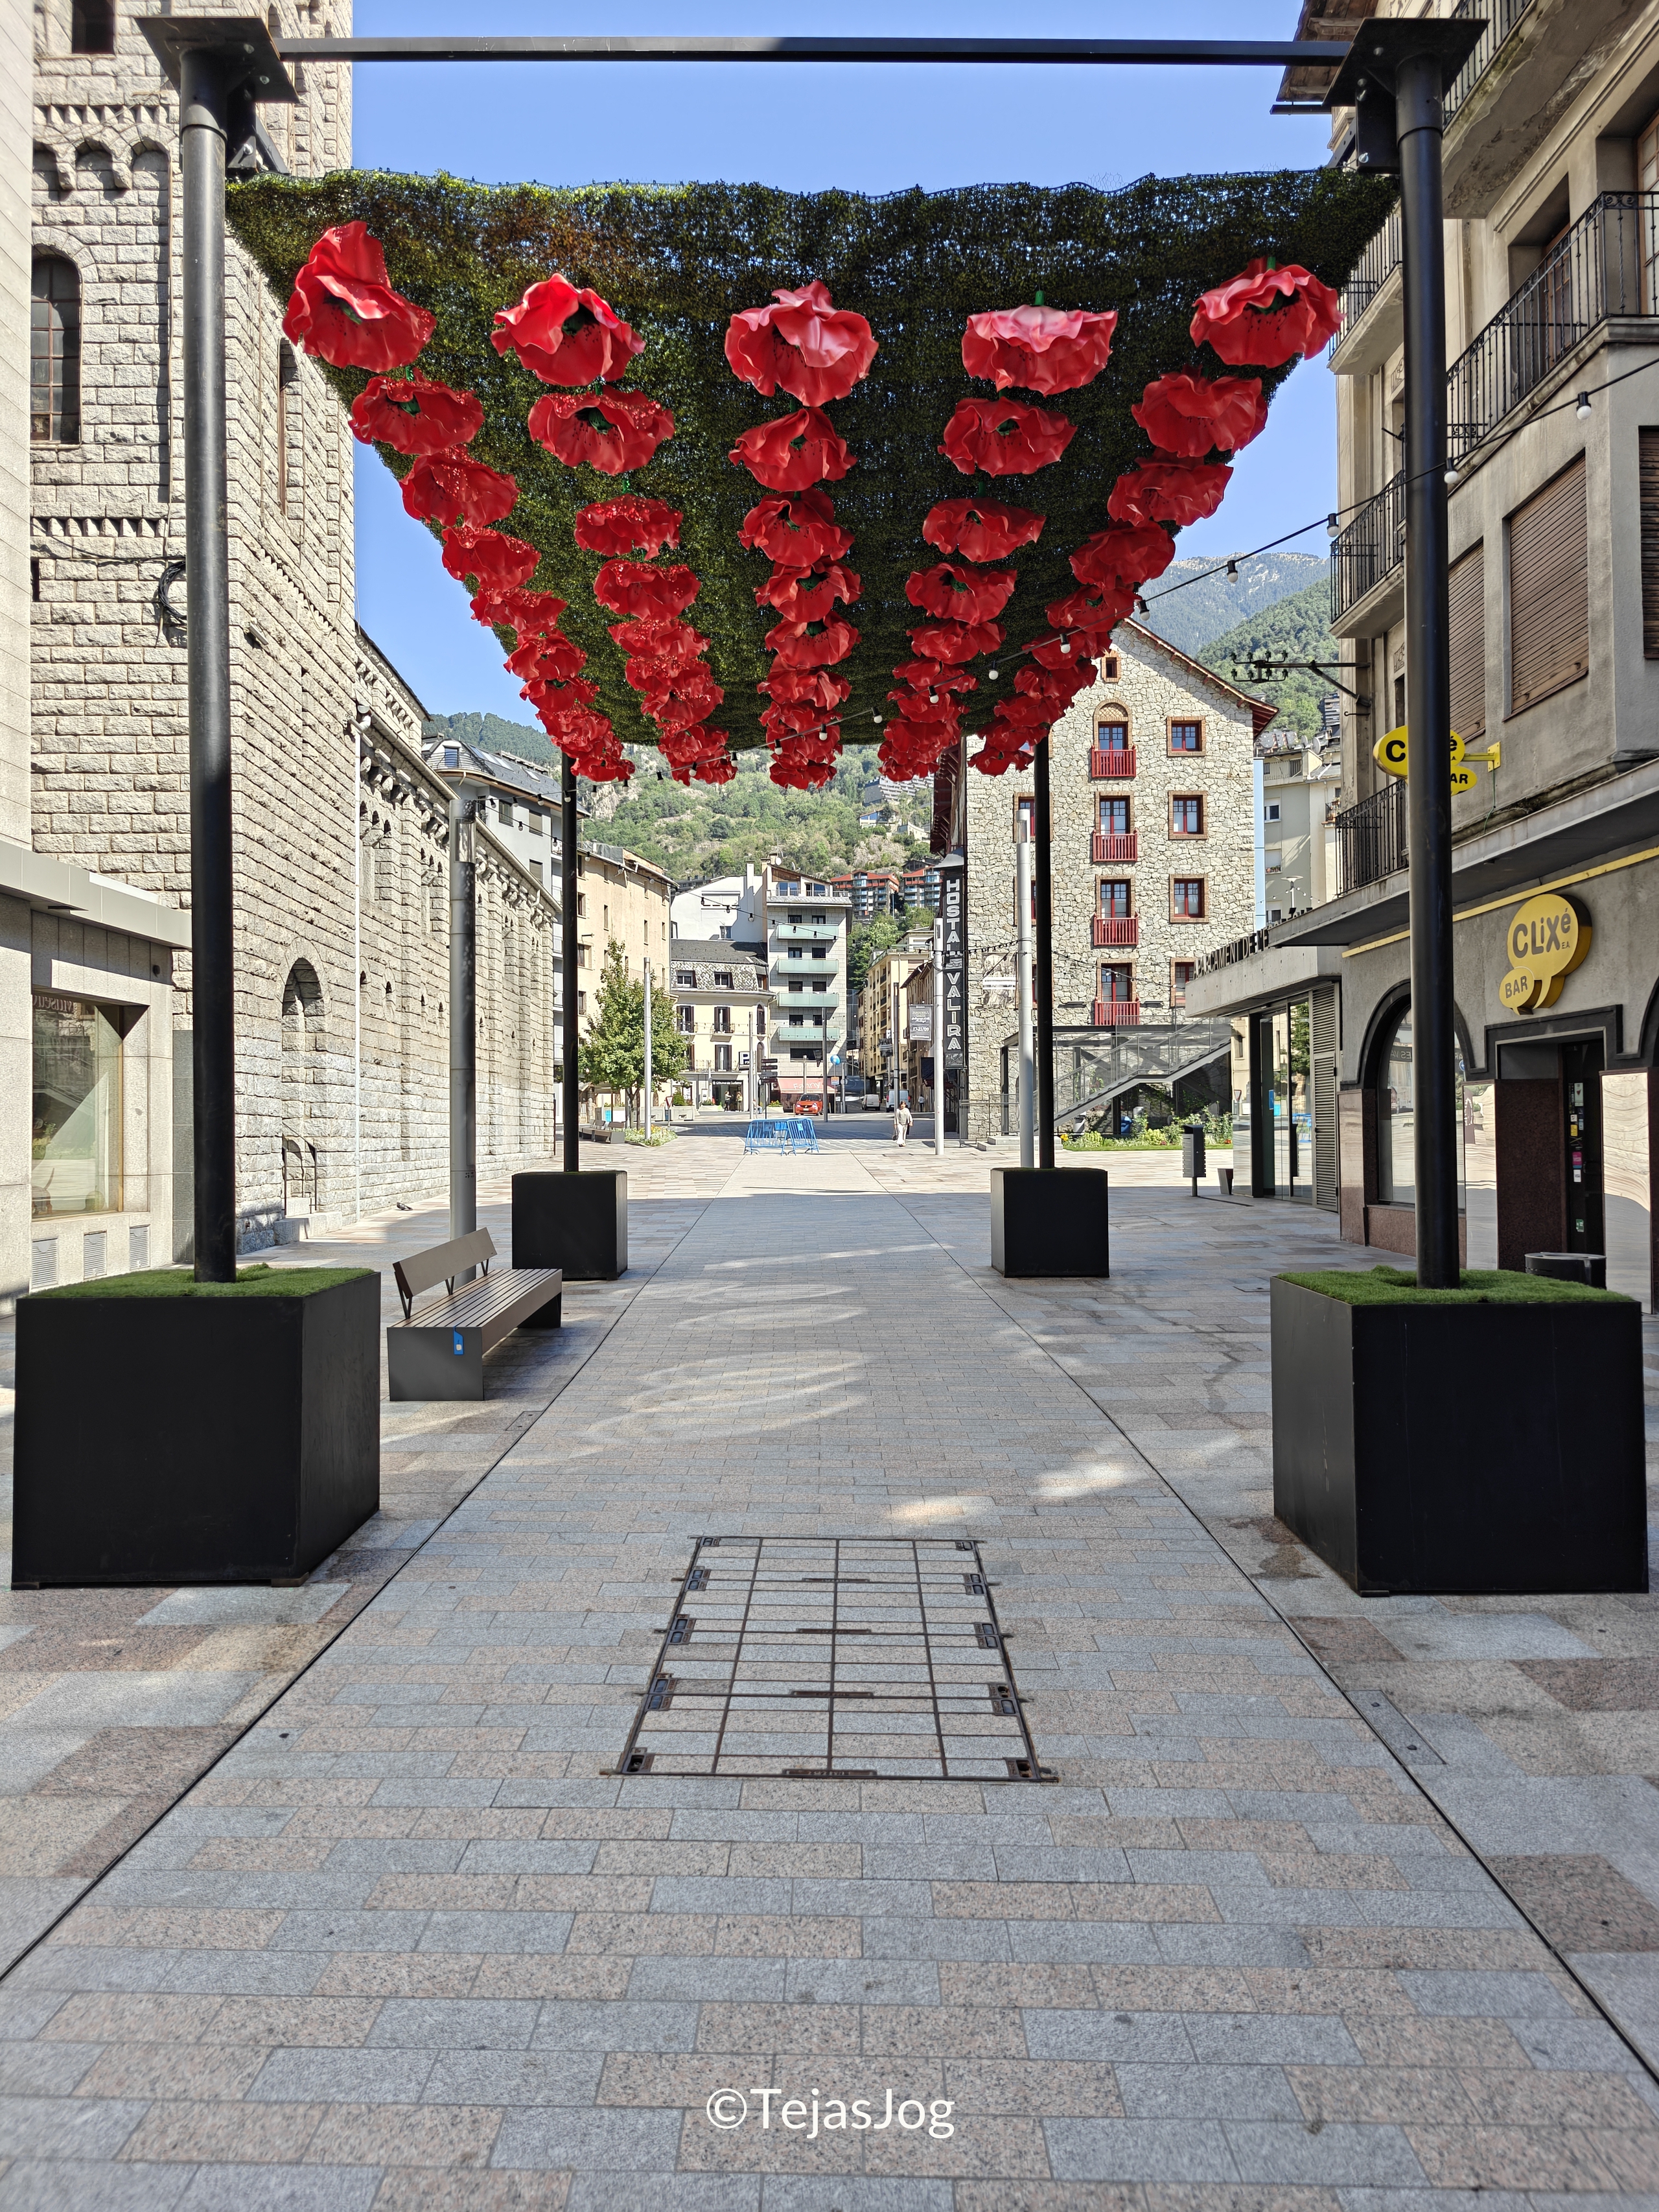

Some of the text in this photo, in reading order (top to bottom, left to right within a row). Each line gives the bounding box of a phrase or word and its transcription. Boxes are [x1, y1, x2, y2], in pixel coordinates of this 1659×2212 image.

[946, 879, 960, 955] HOSTAL
[1193, 939, 1240, 979] APARCAMENT
[1505, 975, 1528, 999] BAR
[947, 972, 962, 1050] VALIRA
[793, 1081, 821, 1089] Fanny
